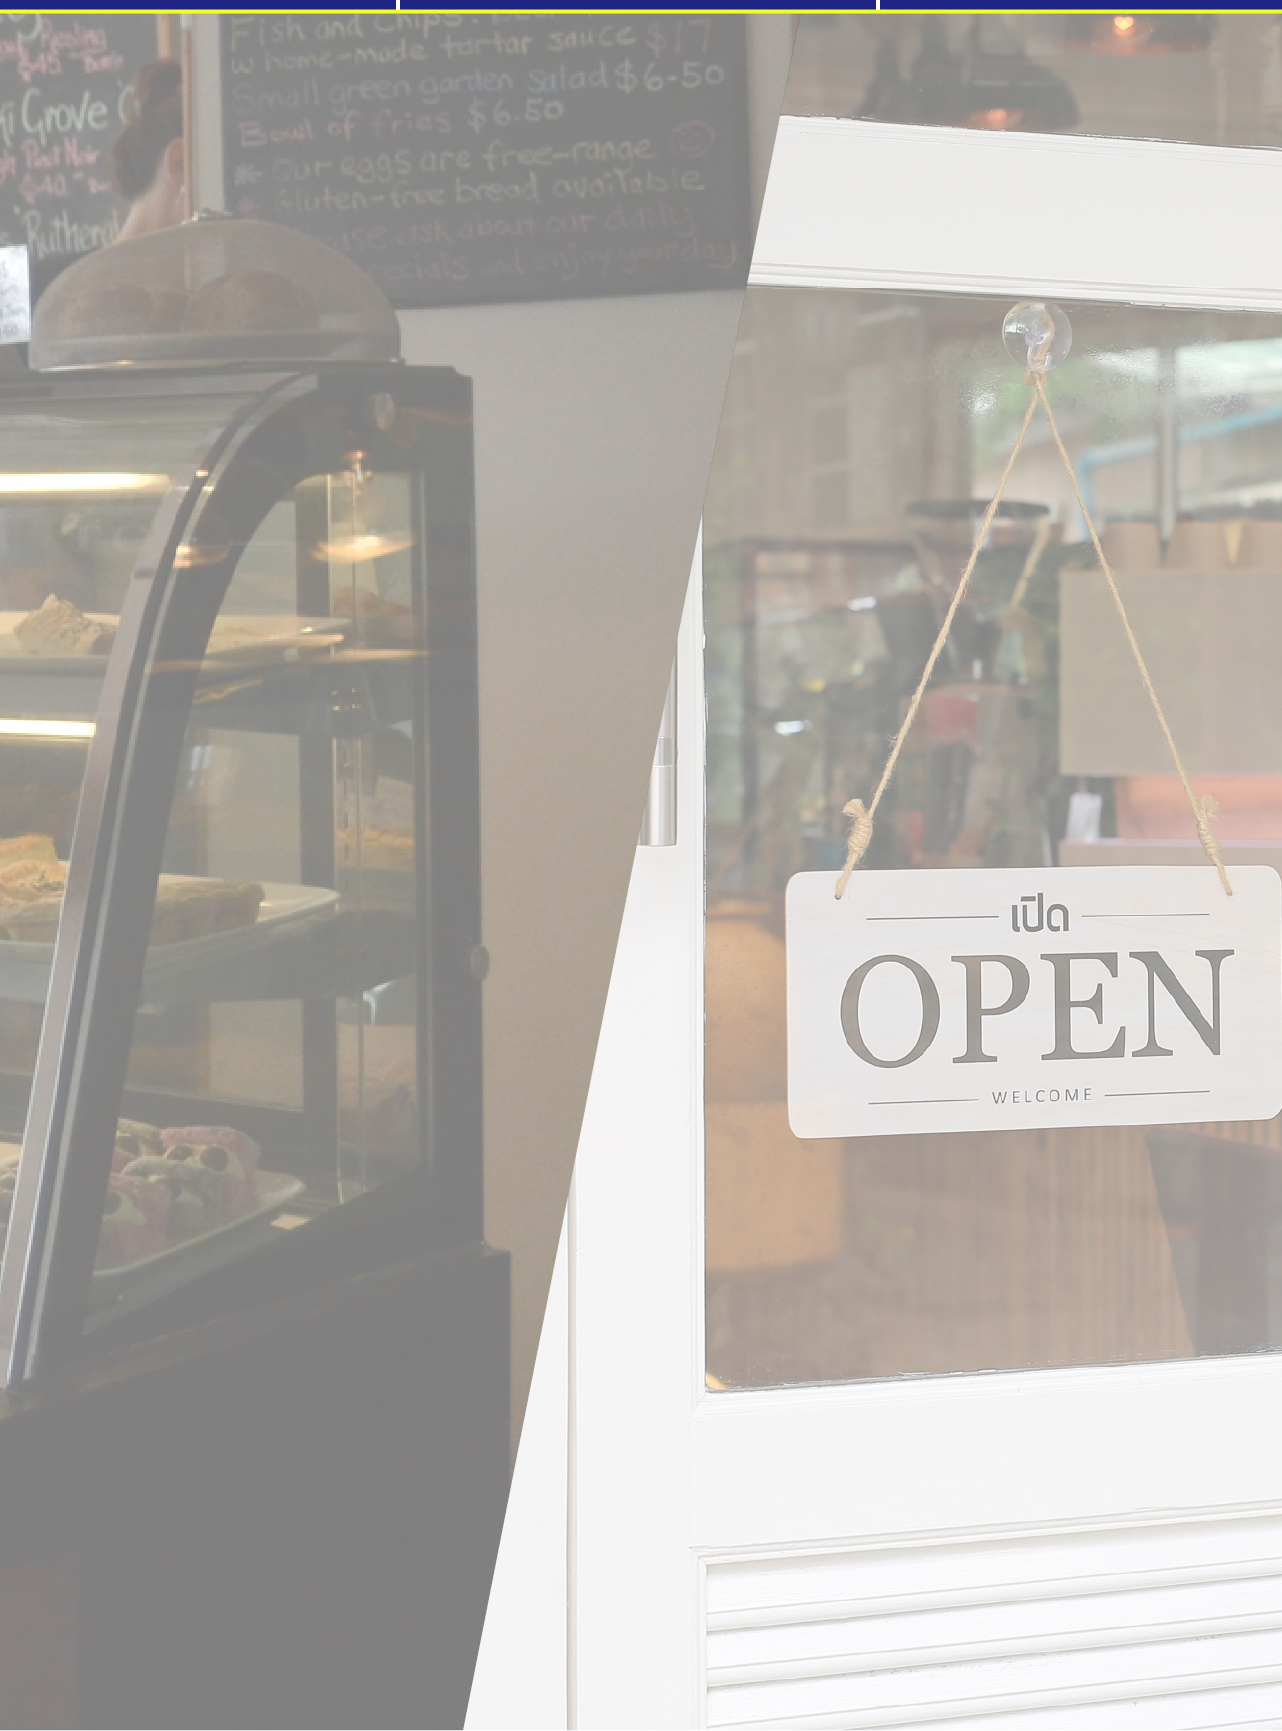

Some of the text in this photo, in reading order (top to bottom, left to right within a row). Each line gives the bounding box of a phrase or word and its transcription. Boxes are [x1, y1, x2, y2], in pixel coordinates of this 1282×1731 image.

[231, 16, 305, 51] Fish
[315, 14, 365, 40] and
[265, 37, 428, 73] home-made
[439, 31, 535, 60] tartar
[547, 24, 638, 52] sauce
[645, 16, 715, 58] $17
[231, 76, 322, 117] Small
[327, 77, 412, 118] green
[419, 65, 514, 106] garden
[20, 87, 109, 147] Grove
[239, 98, 565, 149] Bowl of fries $6.50
[340, 149, 413, 186] eggs
[418, 148, 472, 173] are
[482, 137, 658, 173] free-range
[454, 170, 542, 204] bread
[551, 167, 708, 200] available
[397, 216, 455, 246] ask
[459, 211, 538, 241] about
[545, 213, 598, 235] our
[602, 200, 699, 239] daily
[533, 241, 614, 282] enjoy
[1011, 892, 1070, 932] เปิด
[840, 949, 1235, 1069] OPEN
[992, 1087, 1094, 1104] WELCOME
